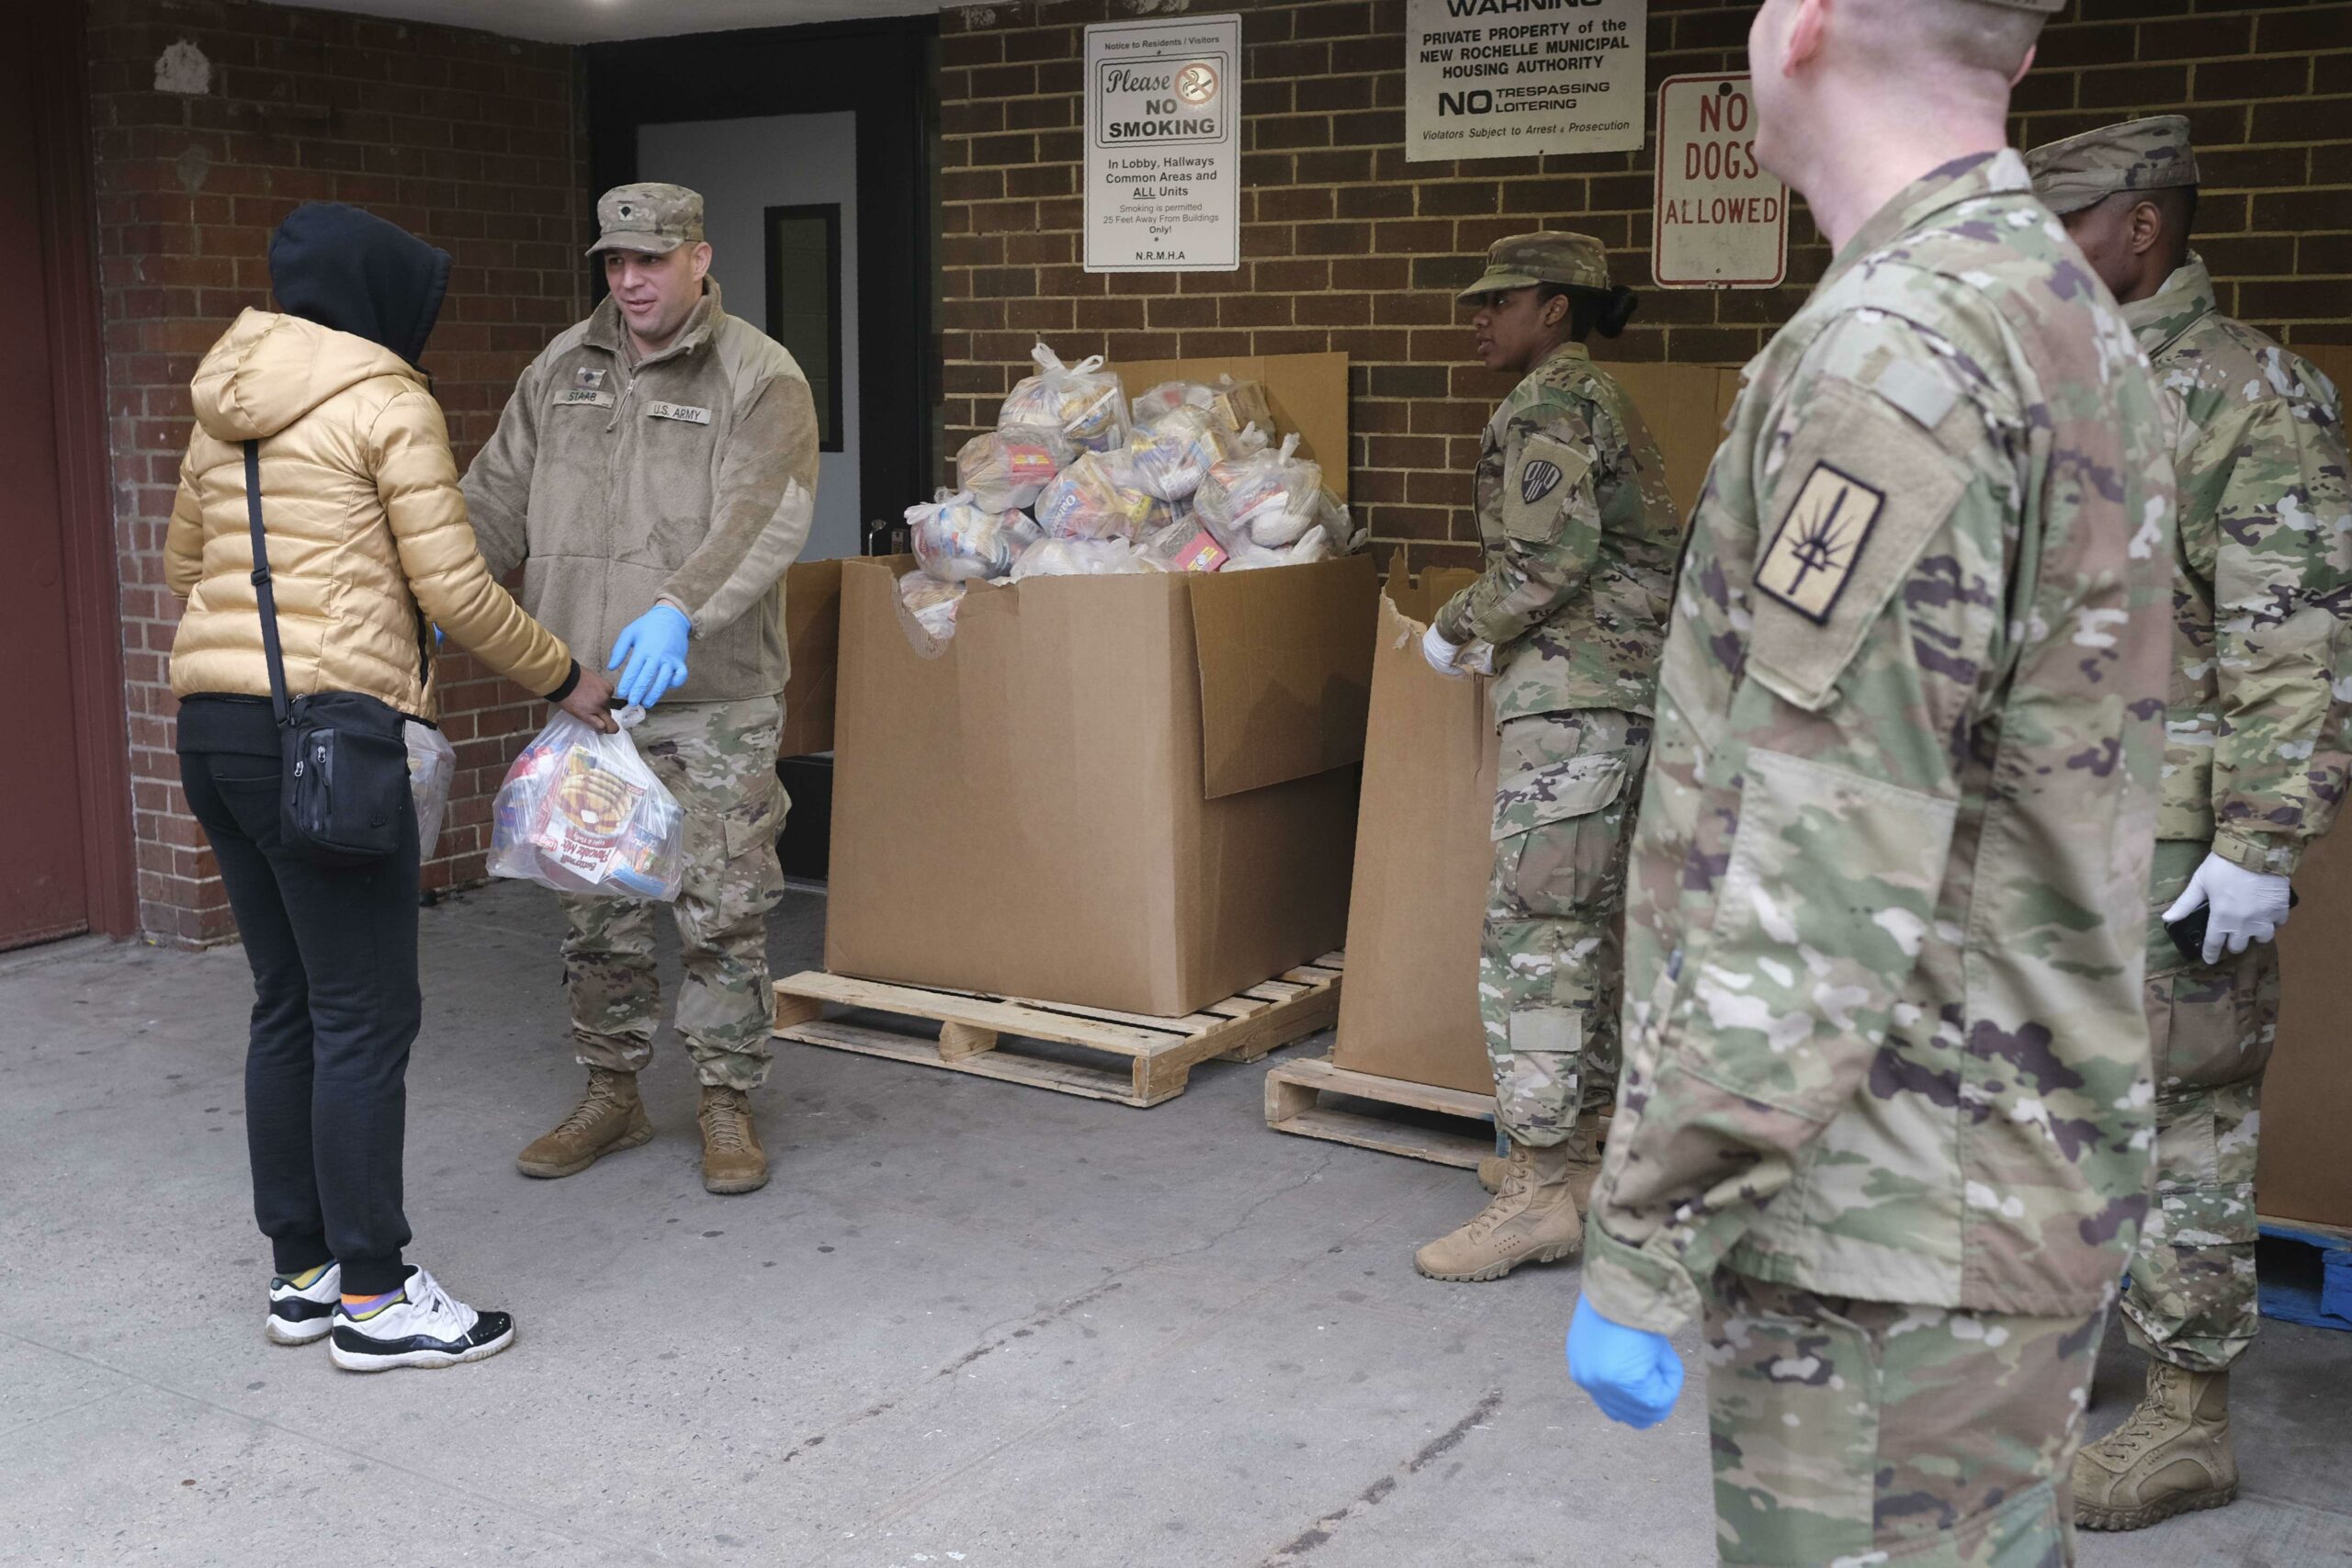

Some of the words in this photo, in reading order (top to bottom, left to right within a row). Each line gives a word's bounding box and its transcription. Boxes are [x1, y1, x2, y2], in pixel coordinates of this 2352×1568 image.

[1448, 0, 1603, 17] WARN
[1423, 29, 1481, 45] PRIVATE
[1489, 22, 1570, 40] PROPERTY
[1578, 20, 1593, 34] of
[1602, 19, 1627, 31] the
[1104, 42, 1130, 51] Notice
[1142, 39, 1182, 48] Residents
[1189, 36, 1219, 45] Visitors
[1420, 49, 1453, 62] NEW
[1461, 42, 1538, 60] ROCHELLE
[1546, 37, 1629, 54] MUNICIPAL
[1442, 62, 1509, 78] HOUSING
[1517, 55, 1603, 73] AUTHORITY
[1106, 69, 1170, 94] Please
[1497, 82, 1610, 98] TRESPASSING
[1146, 99, 1177, 115] NO
[1439, 89, 1492, 117] NO
[1496, 99, 1577, 113] LOITERING
[1700, 93, 1747, 132] NO
[1109, 118, 1215, 138] SMOKING
[1423, 129, 1464, 141] Violators
[1469, 128, 1506, 139] Subject
[1511, 126, 1521, 136] to
[1526, 124, 1556, 134] Arrest
[1569, 120, 1630, 132] Prosecution
[1108, 159, 1118, 169] In
[1122, 157, 1160, 170] Lobby,
[1163, 157, 1215, 168] Hallways
[1685, 141, 1758, 180] DOGS
[1106, 174, 1156, 184] Common
[1159, 172, 1193, 182] Areas
[1195, 171, 1217, 180] and
[1133, 187, 1156, 198] ALL
[1159, 186, 1188, 197] Units
[1120, 204, 1154, 214] Smoking
[1156, 204, 1163, 212] is
[1165, 203, 1202, 213] permitted
[1665, 197, 1778, 224] ALLOWED
[1115, 215, 1134, 223] Feet
[1136, 214, 1157, 224] Away
[1159, 214, 1181, 222] From
[1182, 213, 1219, 222] Buildings
[1149, 225, 1171, 234] Only!
[568, 391, 597, 401] STAAB
[654, 405, 669, 415] U.S.
[673, 408, 701, 420] ARMY
[560, 839, 578, 855] Mix
[576, 846, 611, 863] Pancake
